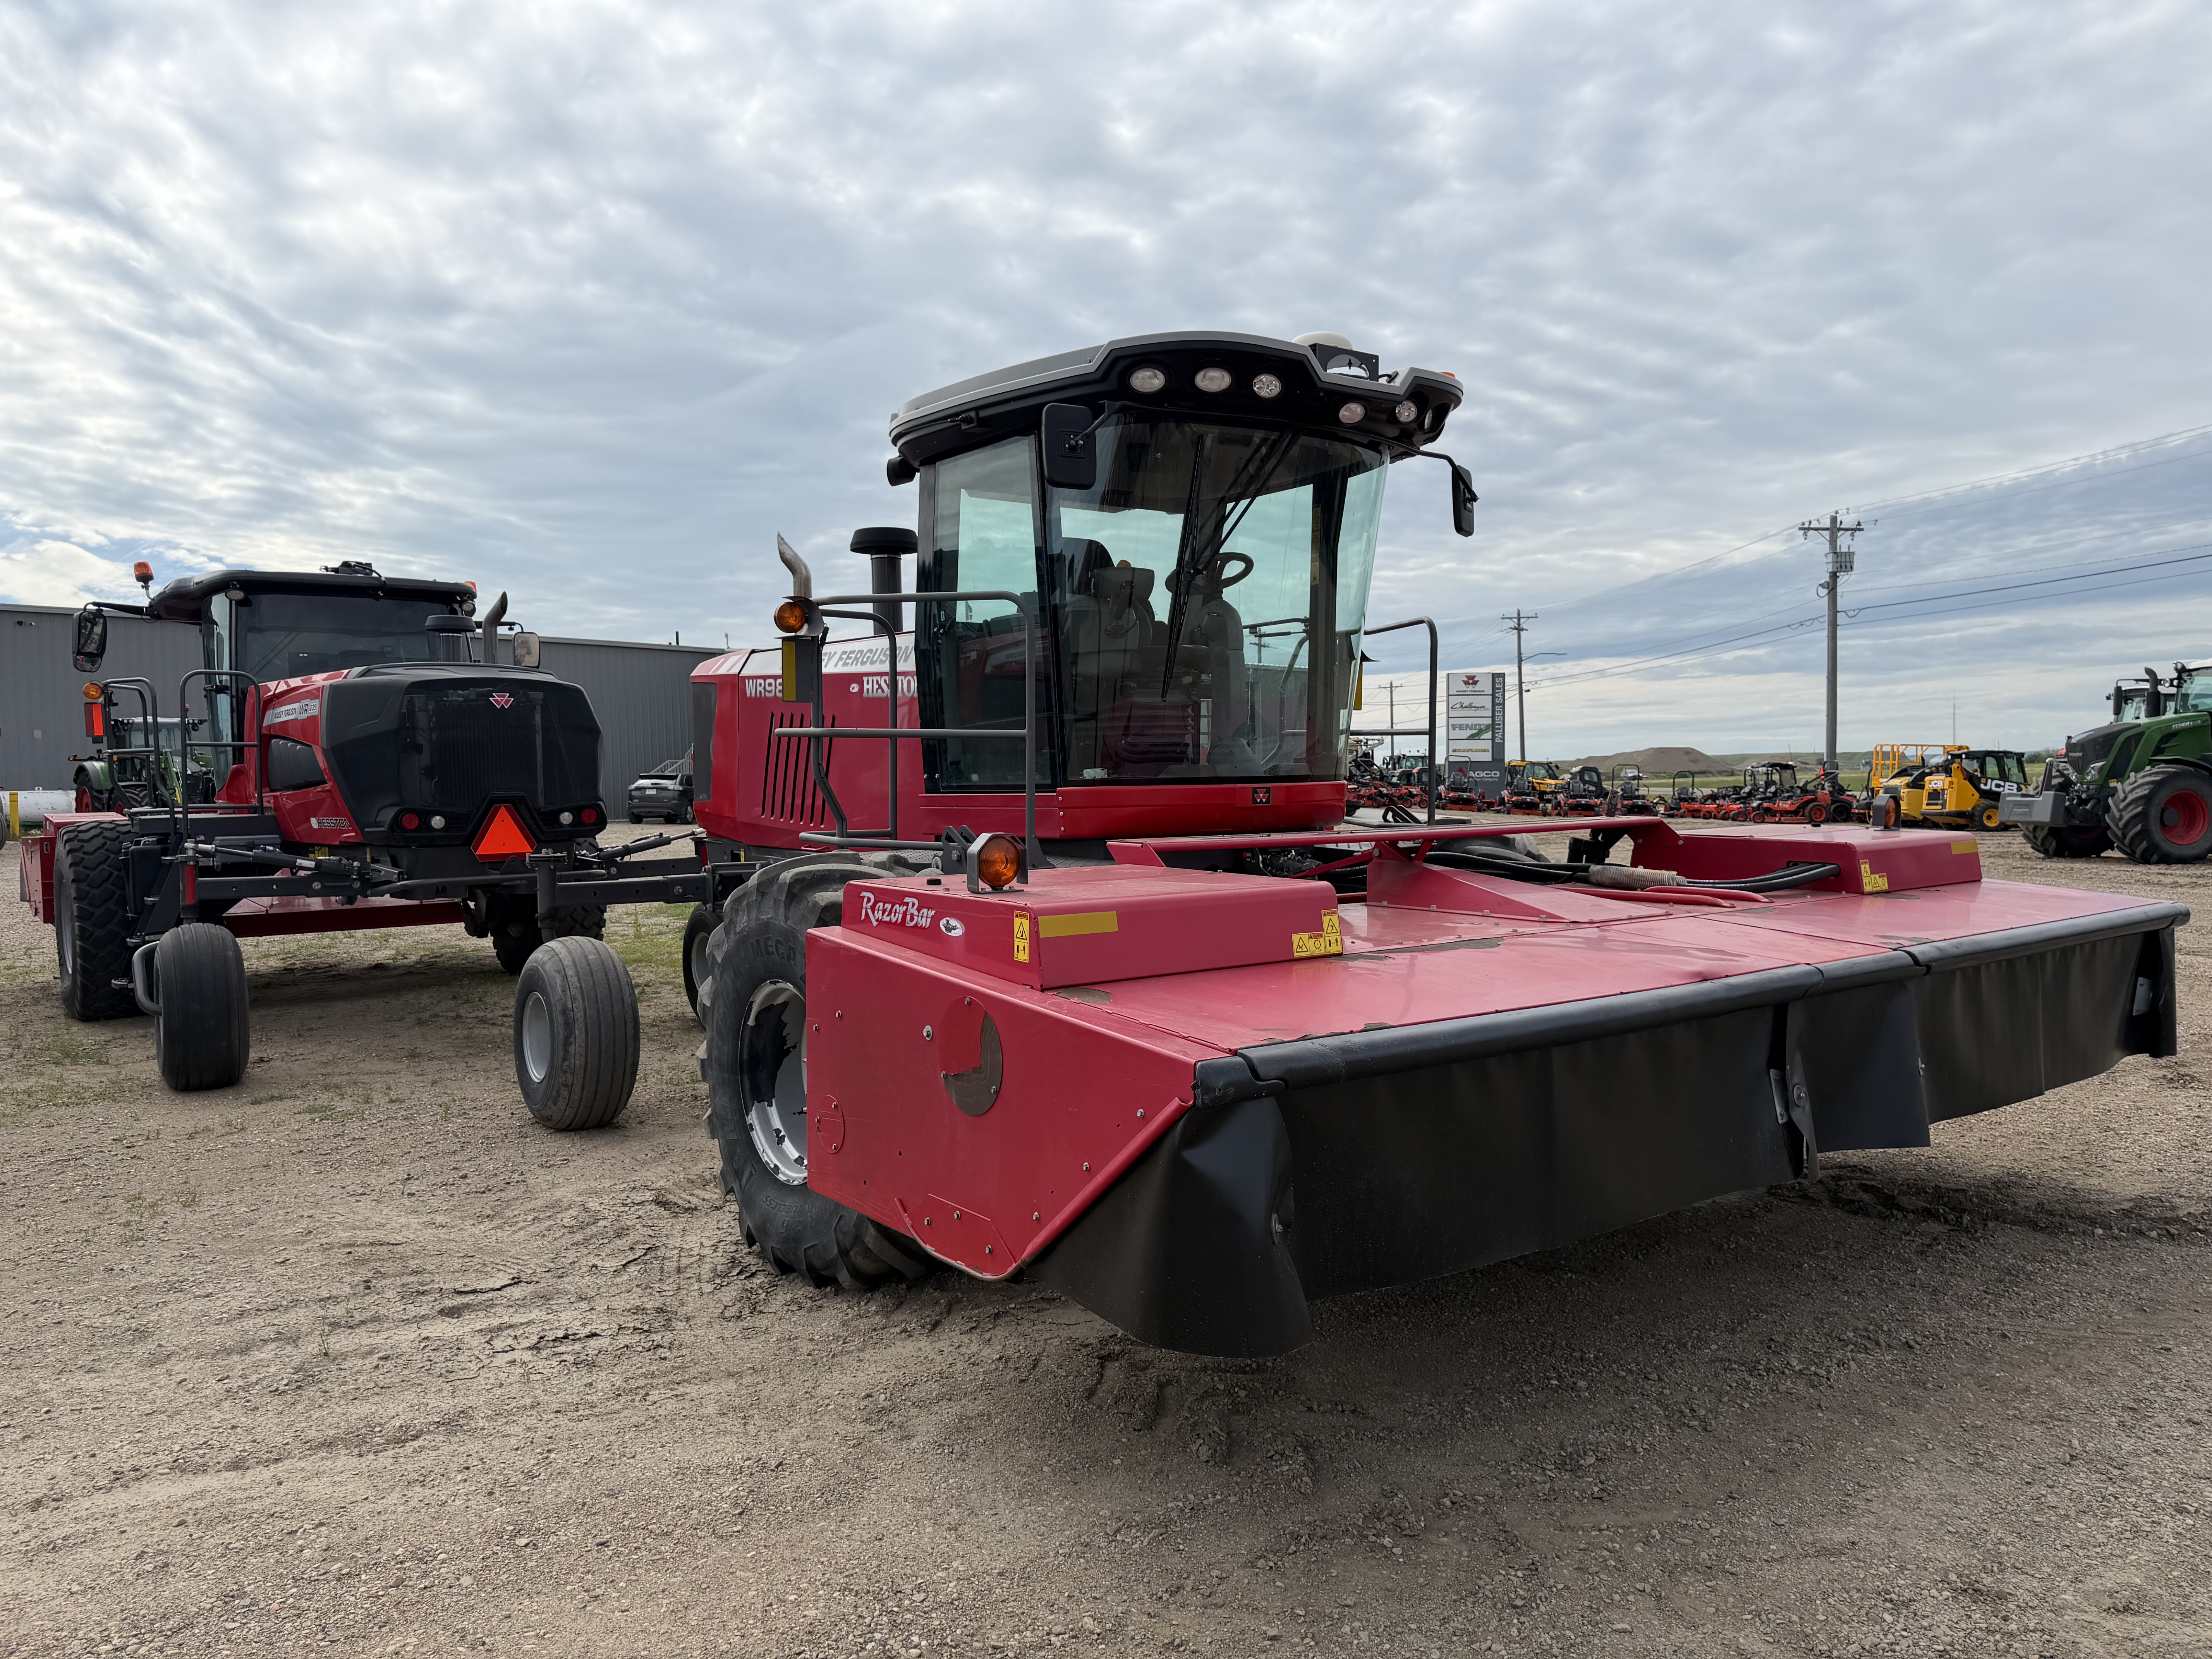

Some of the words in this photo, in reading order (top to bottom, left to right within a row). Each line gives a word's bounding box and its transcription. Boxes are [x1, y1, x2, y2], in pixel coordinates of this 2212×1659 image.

[863, 676, 918, 697] HESTO
[1980, 779, 2018, 792] JCB
[317, 817, 352, 829] HESSTON
